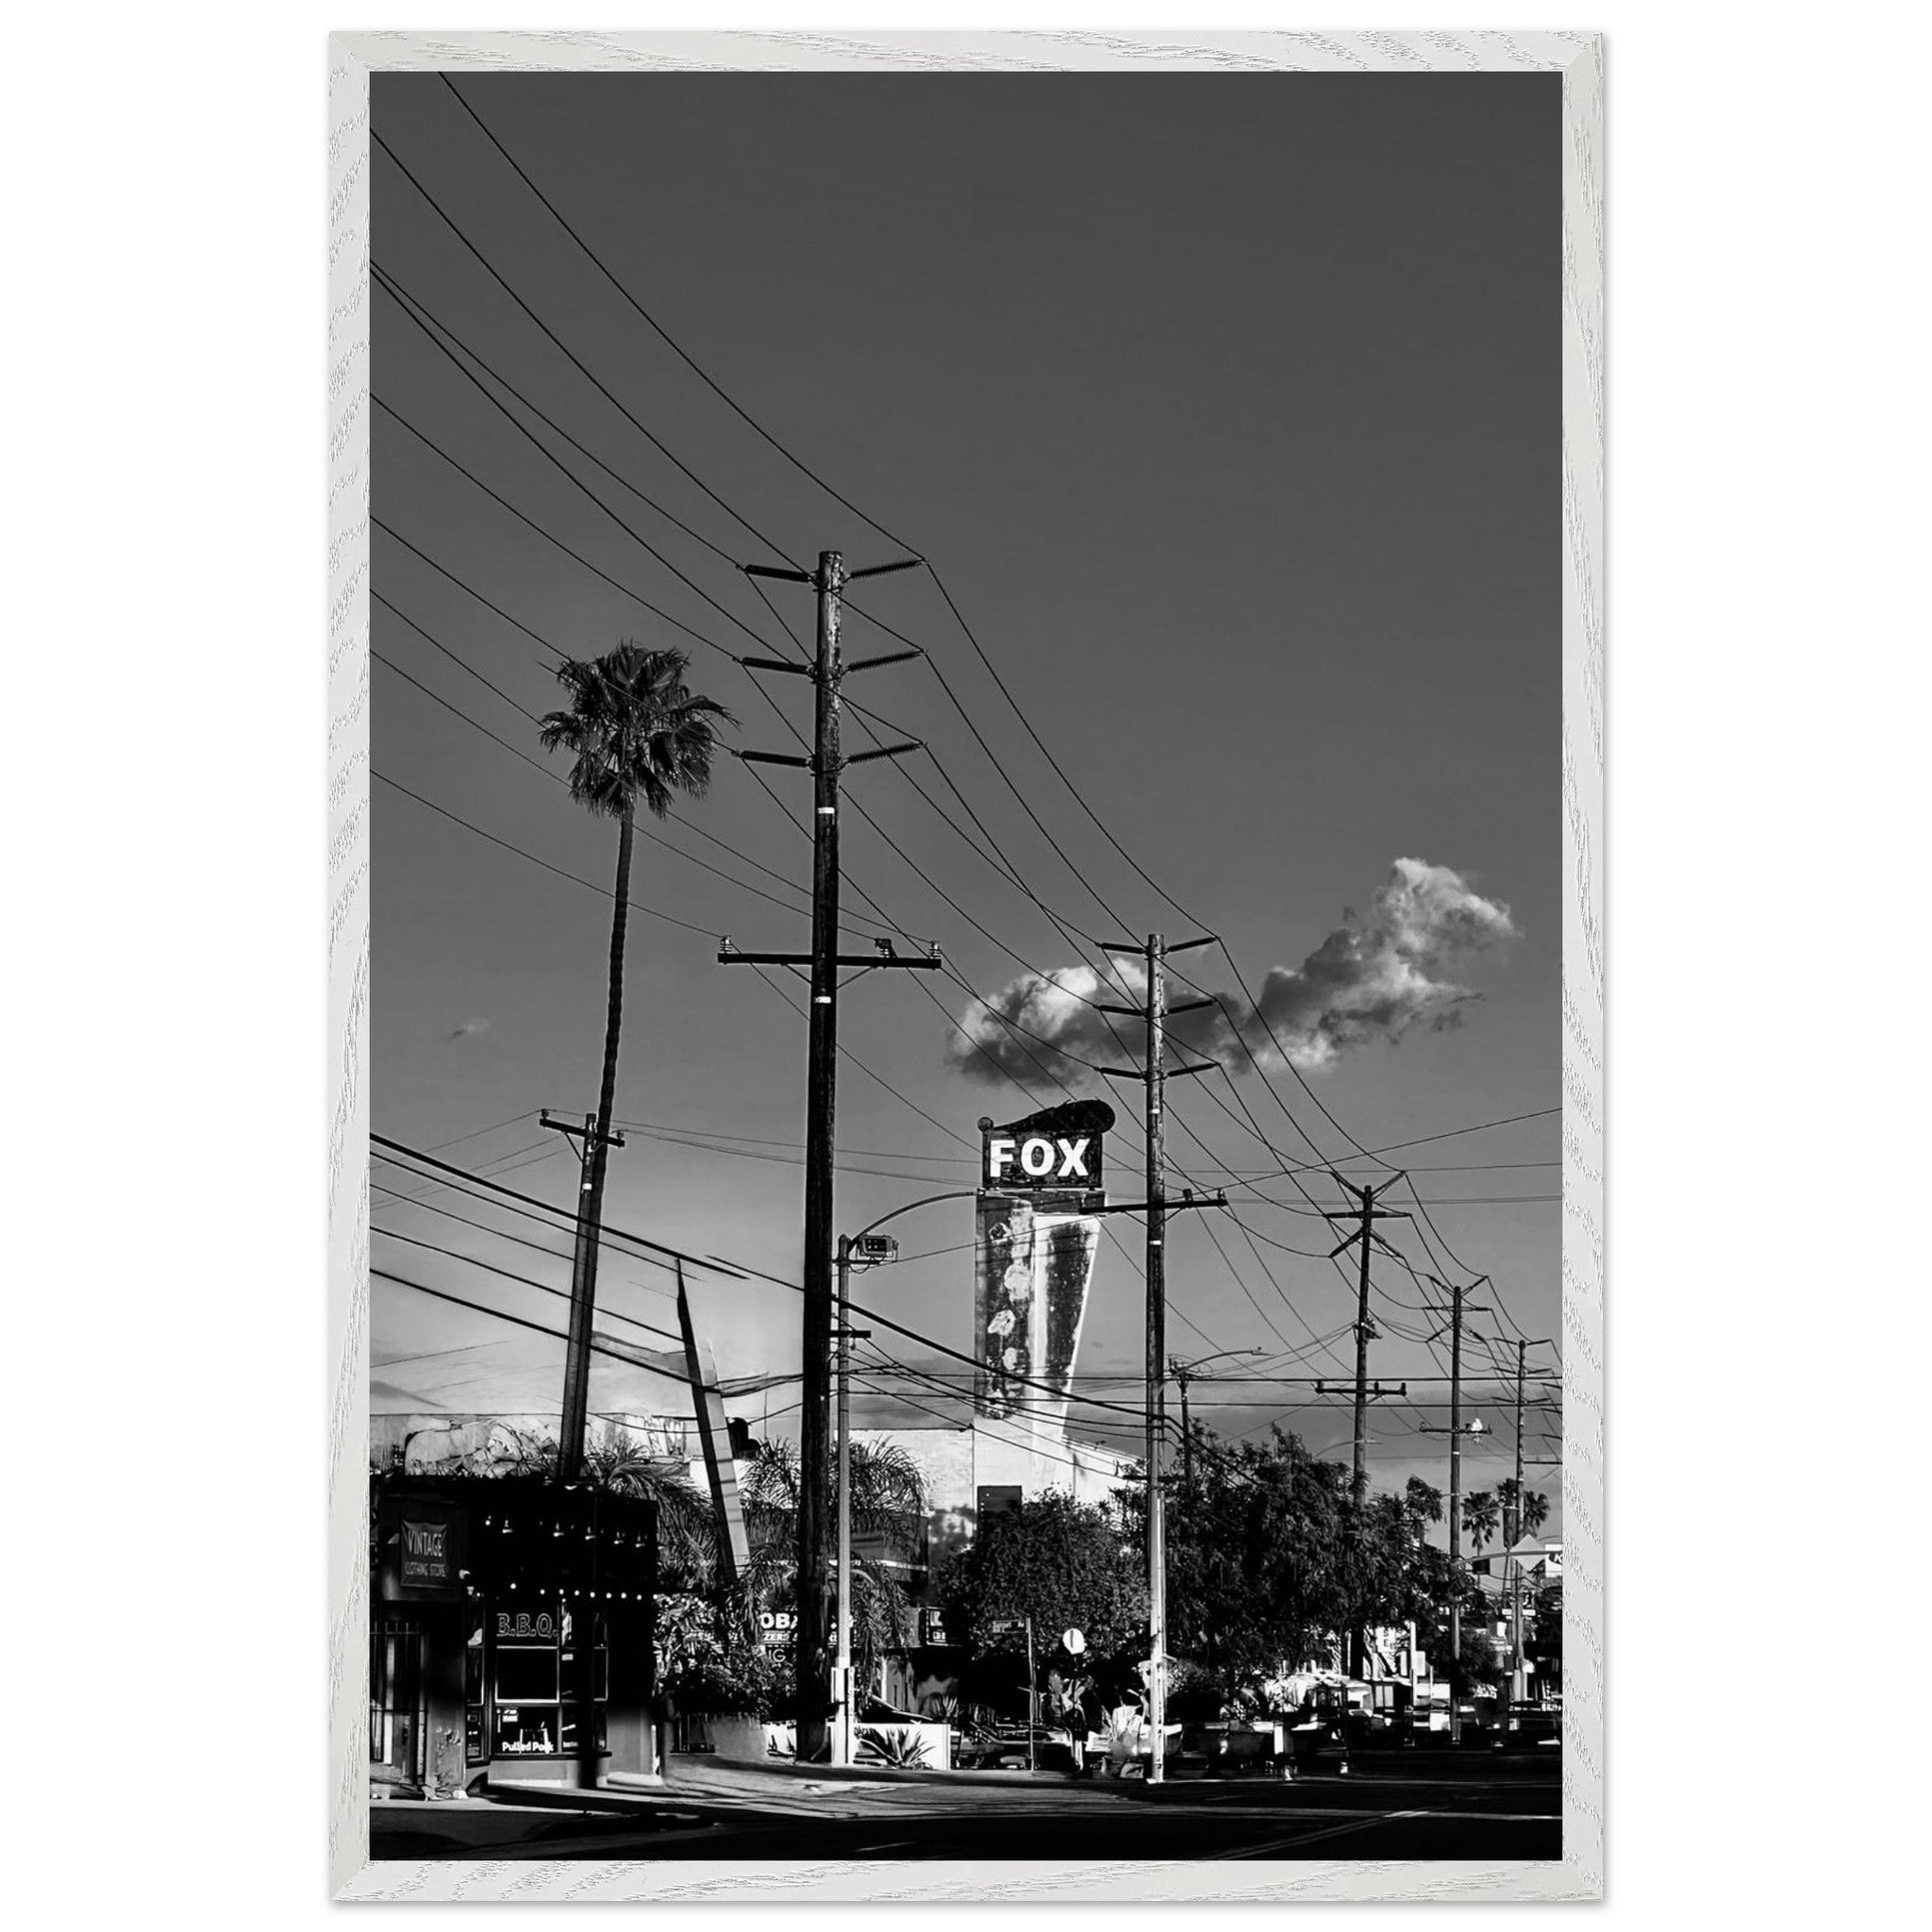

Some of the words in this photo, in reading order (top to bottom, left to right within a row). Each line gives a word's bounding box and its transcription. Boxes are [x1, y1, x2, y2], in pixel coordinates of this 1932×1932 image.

[990, 1138, 1090, 1178] FOX
[408, 1529, 442, 1557] VINTAGE
[496, 1612, 558, 1638] B.B.Q.
